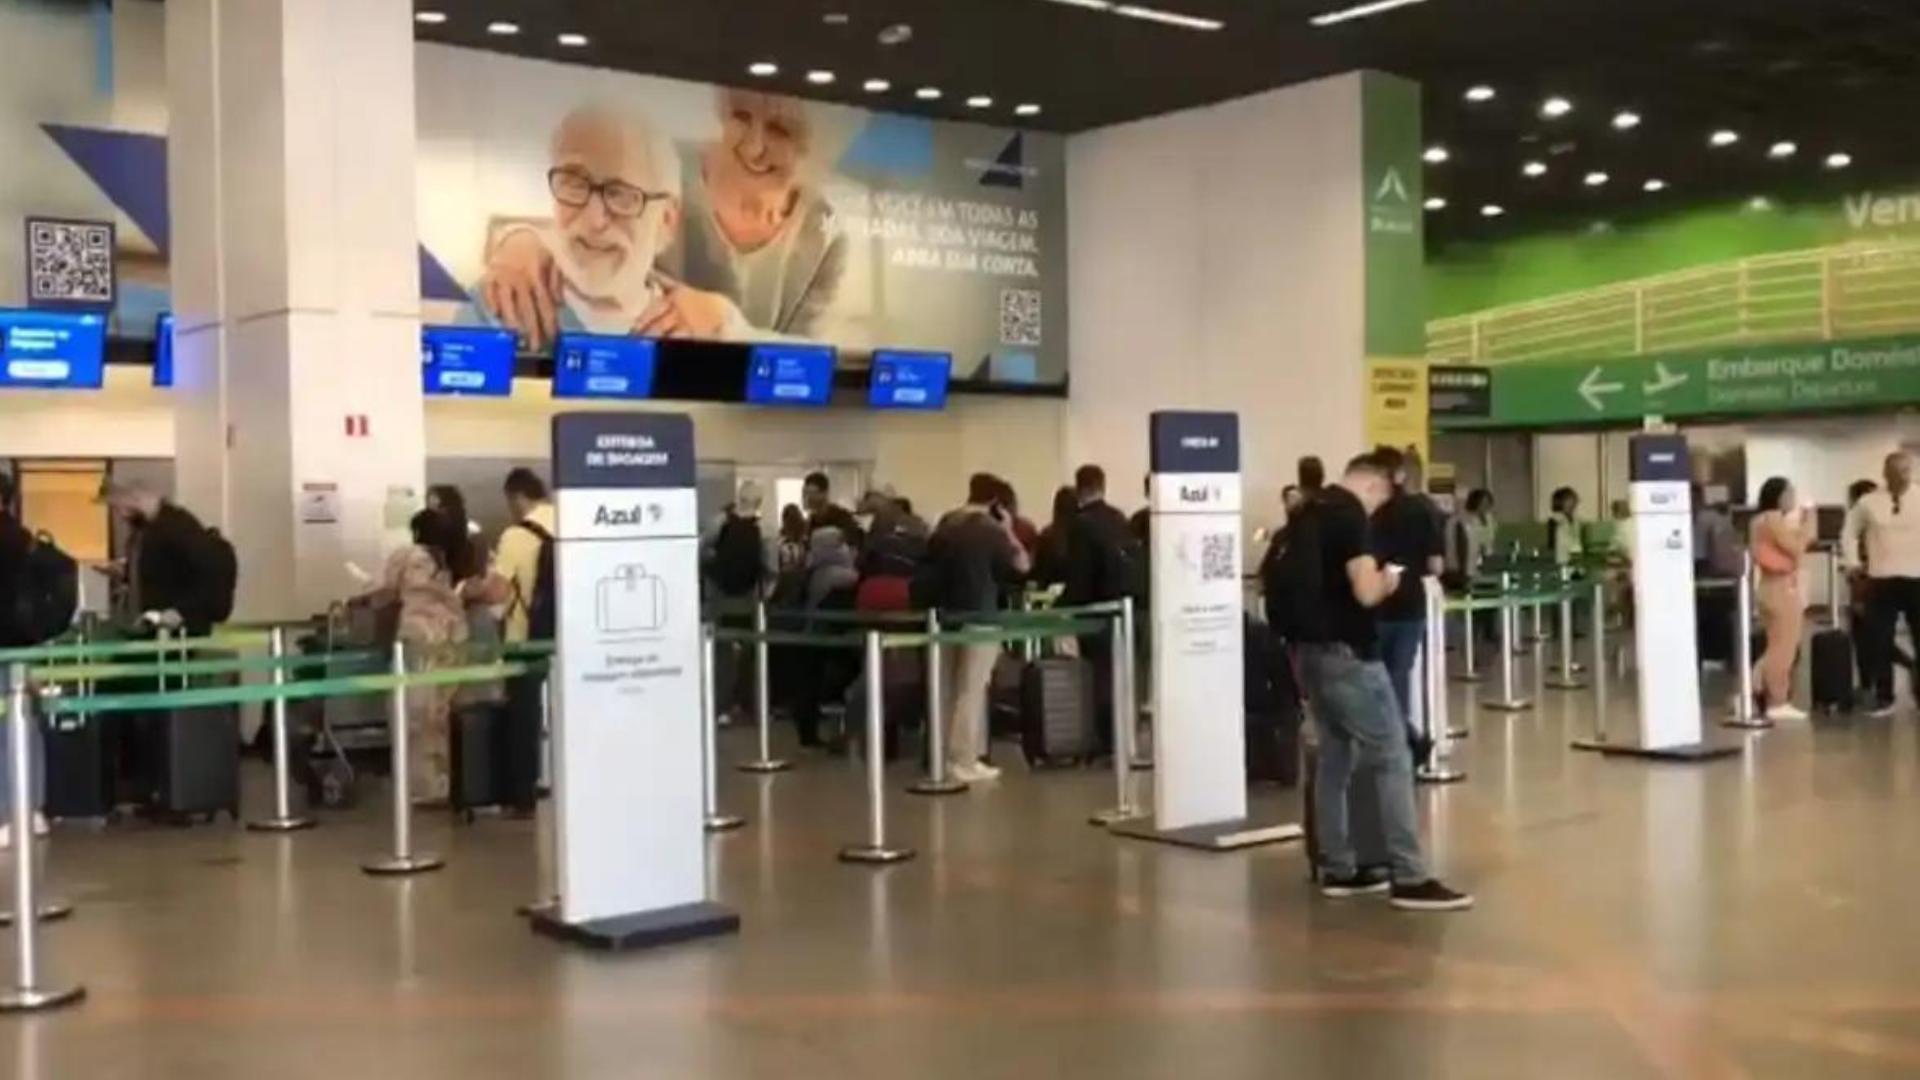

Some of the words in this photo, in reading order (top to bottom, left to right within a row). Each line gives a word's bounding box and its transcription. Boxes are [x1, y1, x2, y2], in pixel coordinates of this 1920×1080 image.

[958, 202, 1015, 227] TODAS
[1018, 210, 1039, 228] AS
[1707, 355, 1826, 380] Embarque
[1180, 485, 1208, 502] Azul
[594, 504, 642, 526] Azul
